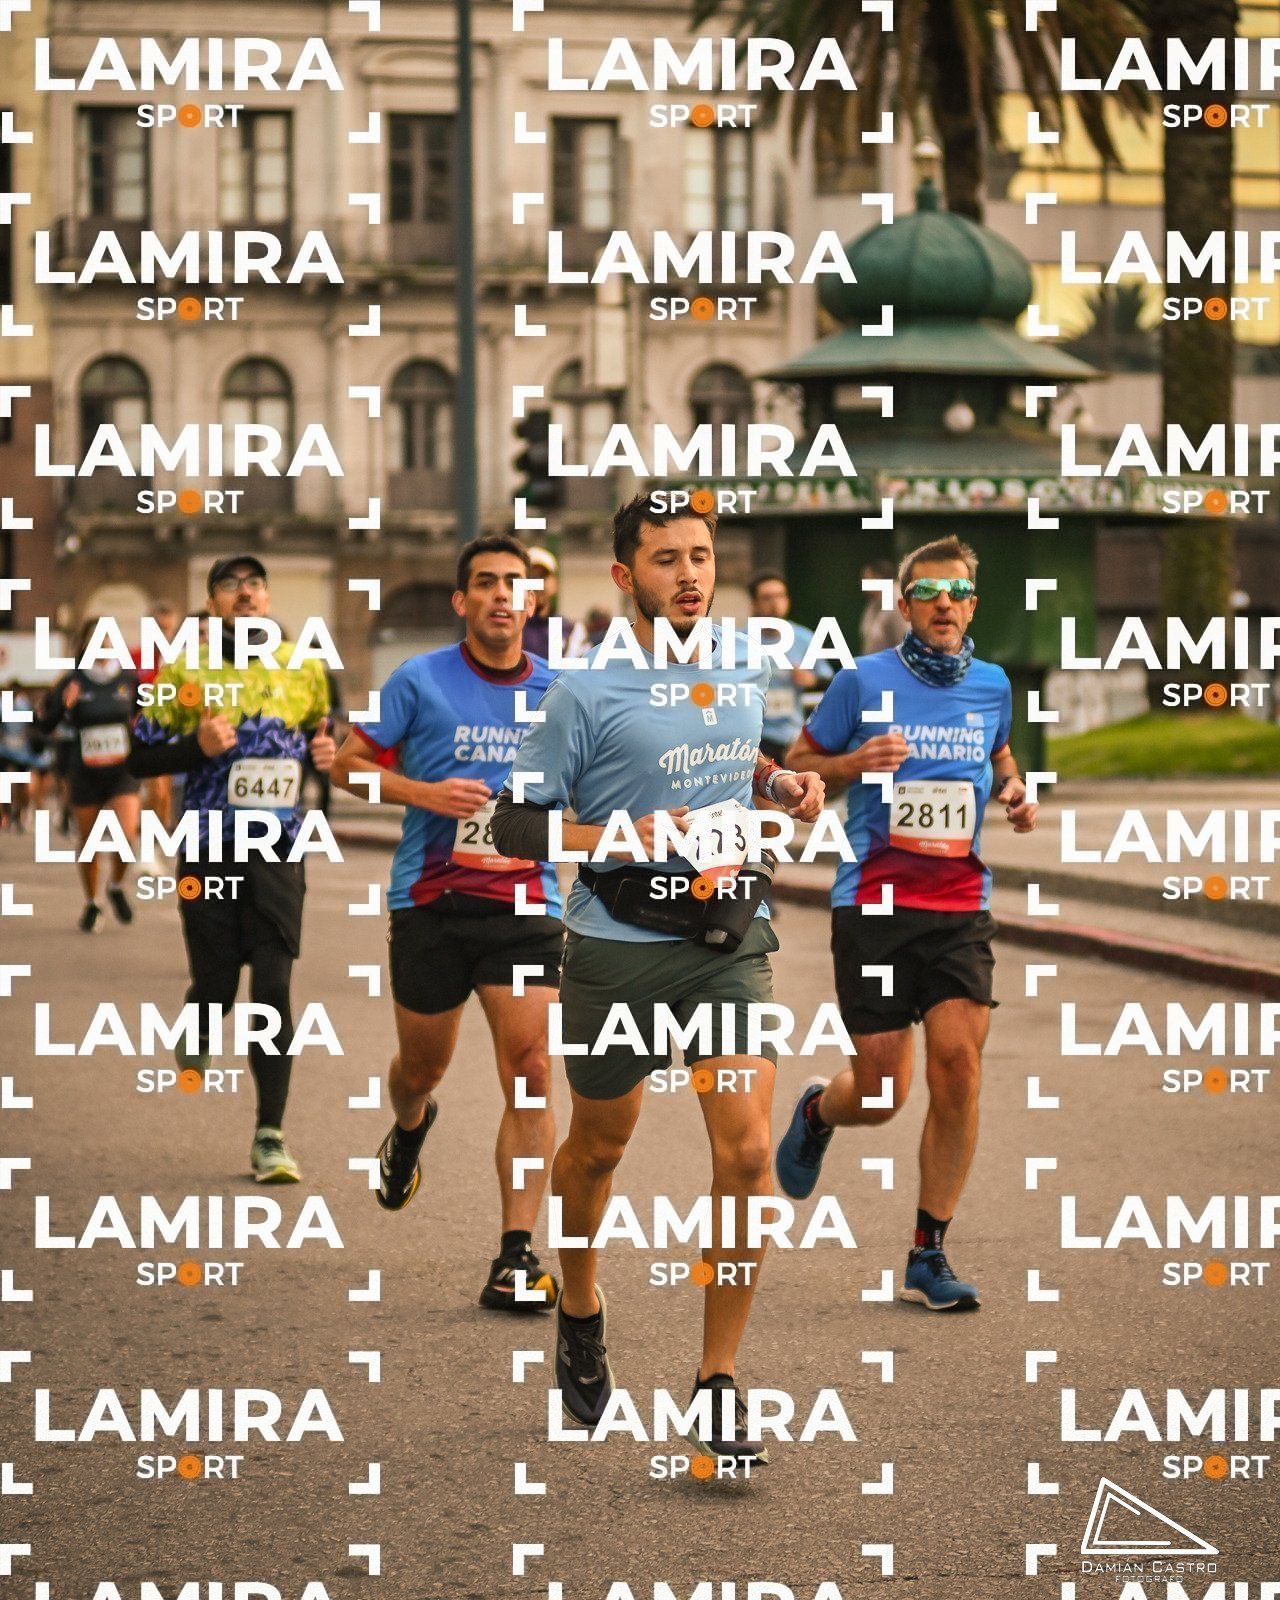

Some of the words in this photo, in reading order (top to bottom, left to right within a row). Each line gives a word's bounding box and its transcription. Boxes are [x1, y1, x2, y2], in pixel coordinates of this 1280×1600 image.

[905, 743, 985, 763] ANARIO
[234, 777, 294, 799] 6447
[896, 802, 966, 829] 2811
[461, 821, 494, 845] 28
